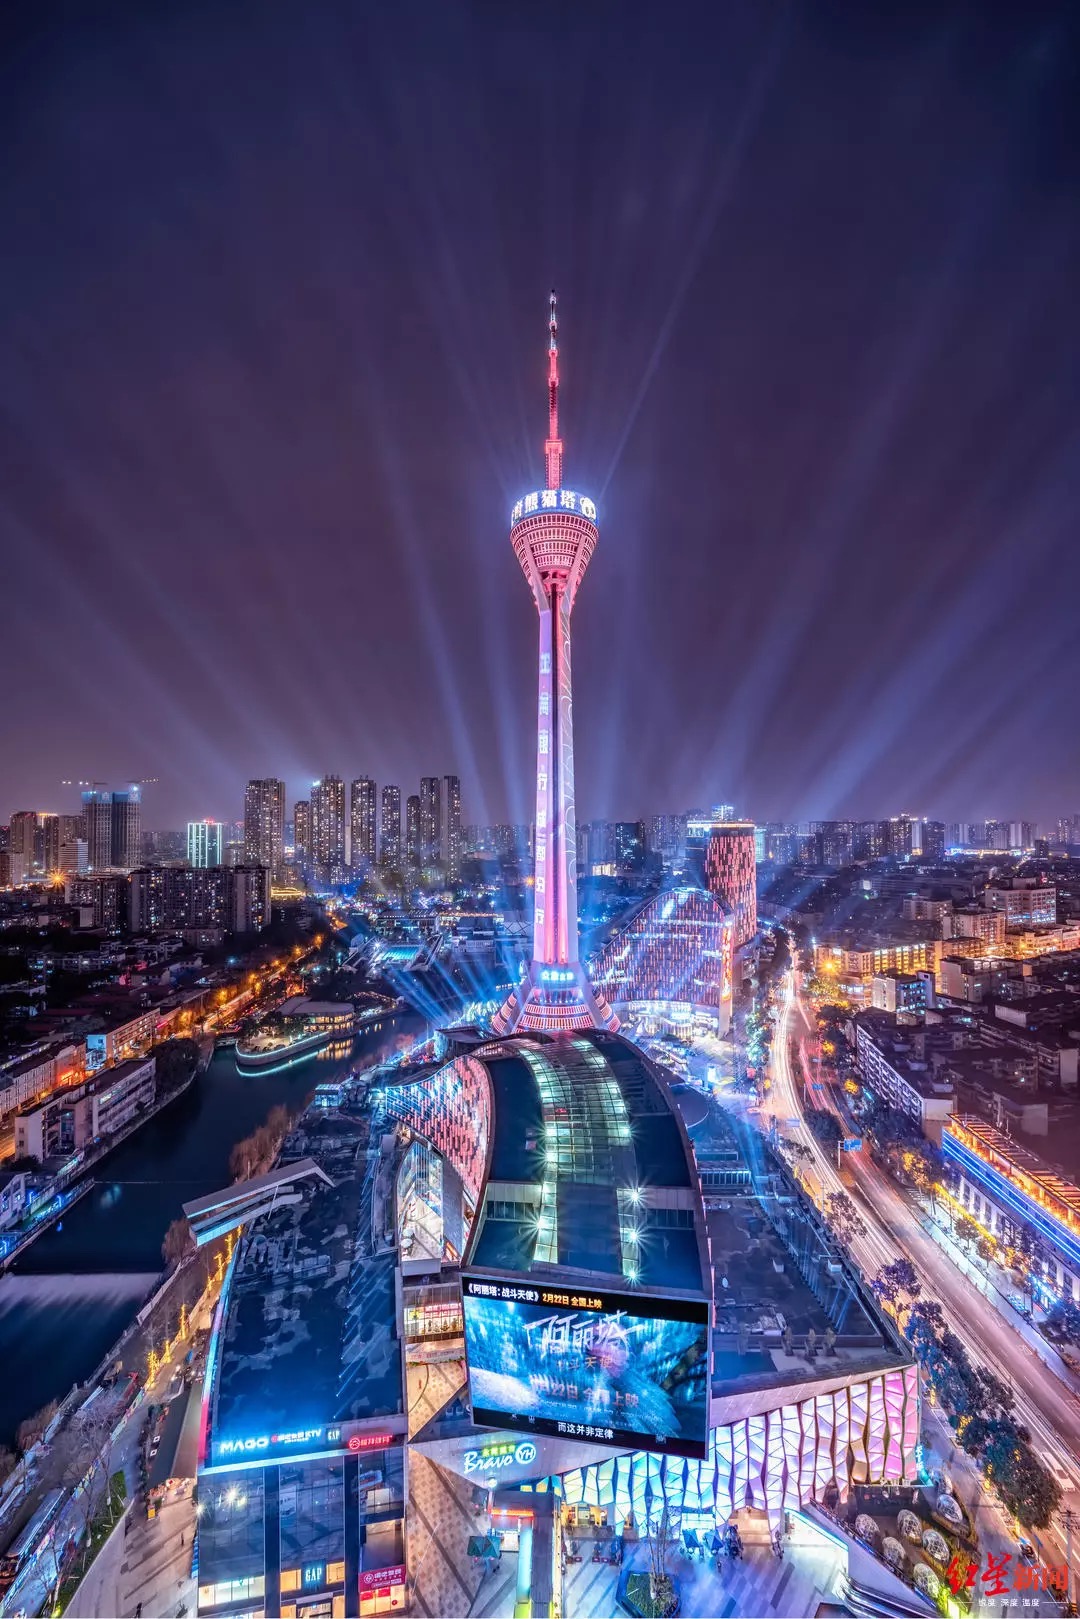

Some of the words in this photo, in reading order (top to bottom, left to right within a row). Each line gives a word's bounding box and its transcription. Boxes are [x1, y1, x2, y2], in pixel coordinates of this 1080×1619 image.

[542, 1293, 570, 1305] 2月22日
[571, 1296, 603, 1309] 全国上映
[327, 1428, 340, 1441] GAP
[558, 1421, 614, 1440] 而这并非定律
[463, 1451, 514, 1474] Bravo
[305, 1567, 322, 1582] GAP
